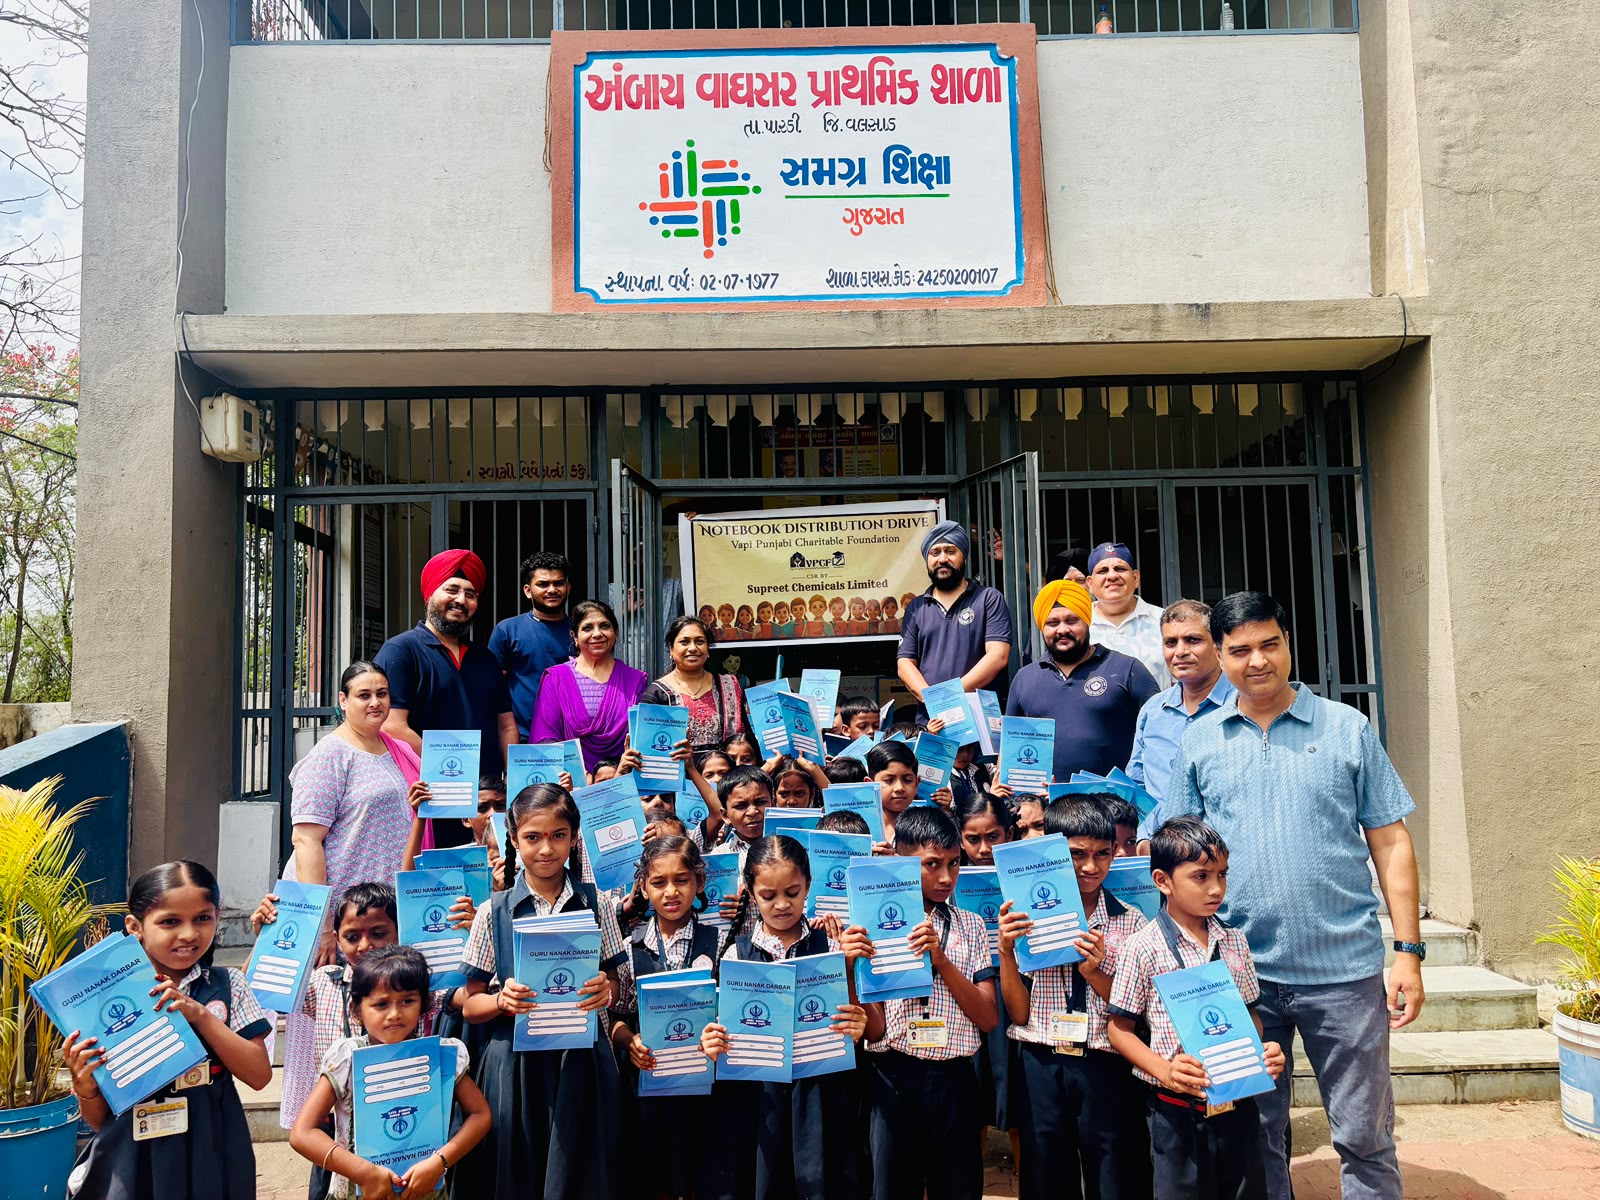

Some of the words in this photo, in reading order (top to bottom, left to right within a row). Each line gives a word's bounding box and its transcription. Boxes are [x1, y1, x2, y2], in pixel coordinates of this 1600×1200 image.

[696, 72, 796, 108] વાઘસર
[807, 55, 919, 109] પ્રાથમિક
[930, 63, 1001, 104] શાળા
[779, 157, 867, 188] સમગ્ર
[882, 144, 951, 190] શિક્ષા
[842, 207, 905, 236] ગુજરાત
[917, 267, 999, 286] 24250200107
[698, 523, 781, 538] NOTEBOOK
[783, 519, 883, 534] DISTRIBUTION
[885, 517, 929, 529] DRIVE
[731, 540, 752, 551] Vapi
[756, 538, 792, 550] Punjabi
[795, 536, 843, 547] Charitable
[847, 534, 900, 545] Foundation
[747, 583, 789, 595] Supreet
[791, 580, 845, 593] Chemicals
[847, 578, 889, 590] Limited
[1008, 867, 1024, 875] GURU
[1025, 863, 1046, 871] NANAK
[1046, 857, 1070, 867] DARBAR
[896, 879, 920, 888] DARBAR
[62, 992, 84, 1008] GURU
[84, 975, 111, 994] NANAK
[111, 957, 141, 979] DARBAR
[744, 981, 765, 989] NANAK
[796, 976, 818, 985] NANAK
[818, 972, 843, 981] DARBAR
[1170, 991, 1187, 1001] GURU
[1187, 985, 1207, 996] NANAK
[1207, 979, 1231, 990] DARBAR
